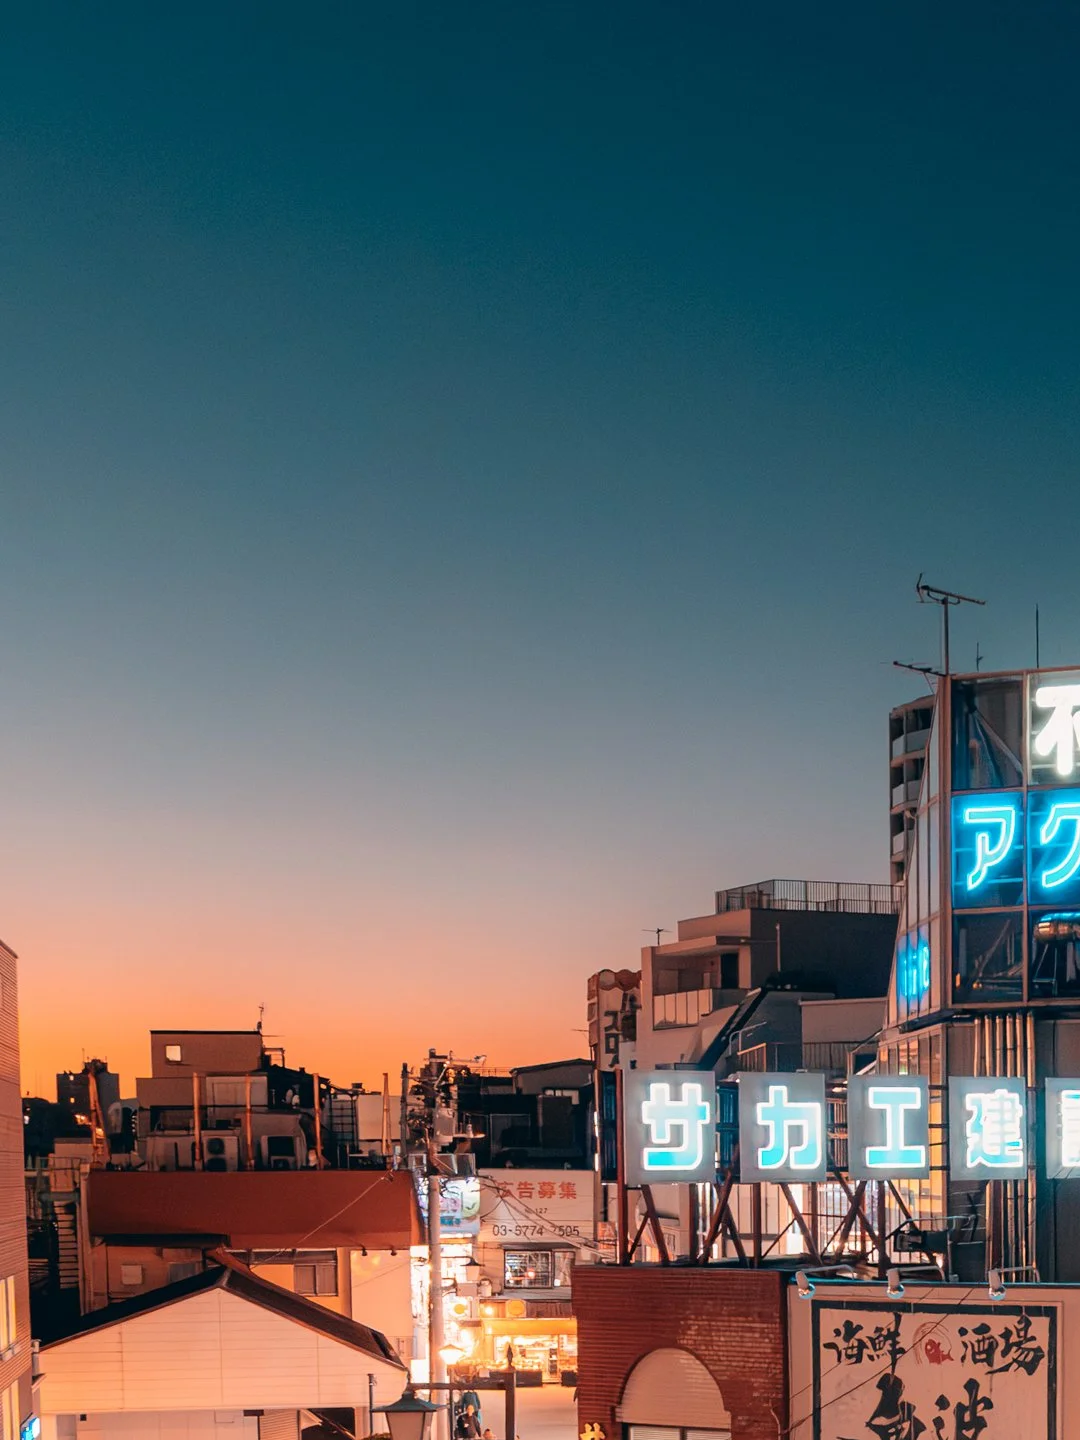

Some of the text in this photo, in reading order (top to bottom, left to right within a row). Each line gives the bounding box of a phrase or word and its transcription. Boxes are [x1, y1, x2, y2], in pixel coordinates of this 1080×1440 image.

[496, 1181, 577, 1199] 広告募集
[823, 1312, 1046, 1376] 海鮮 酒場
